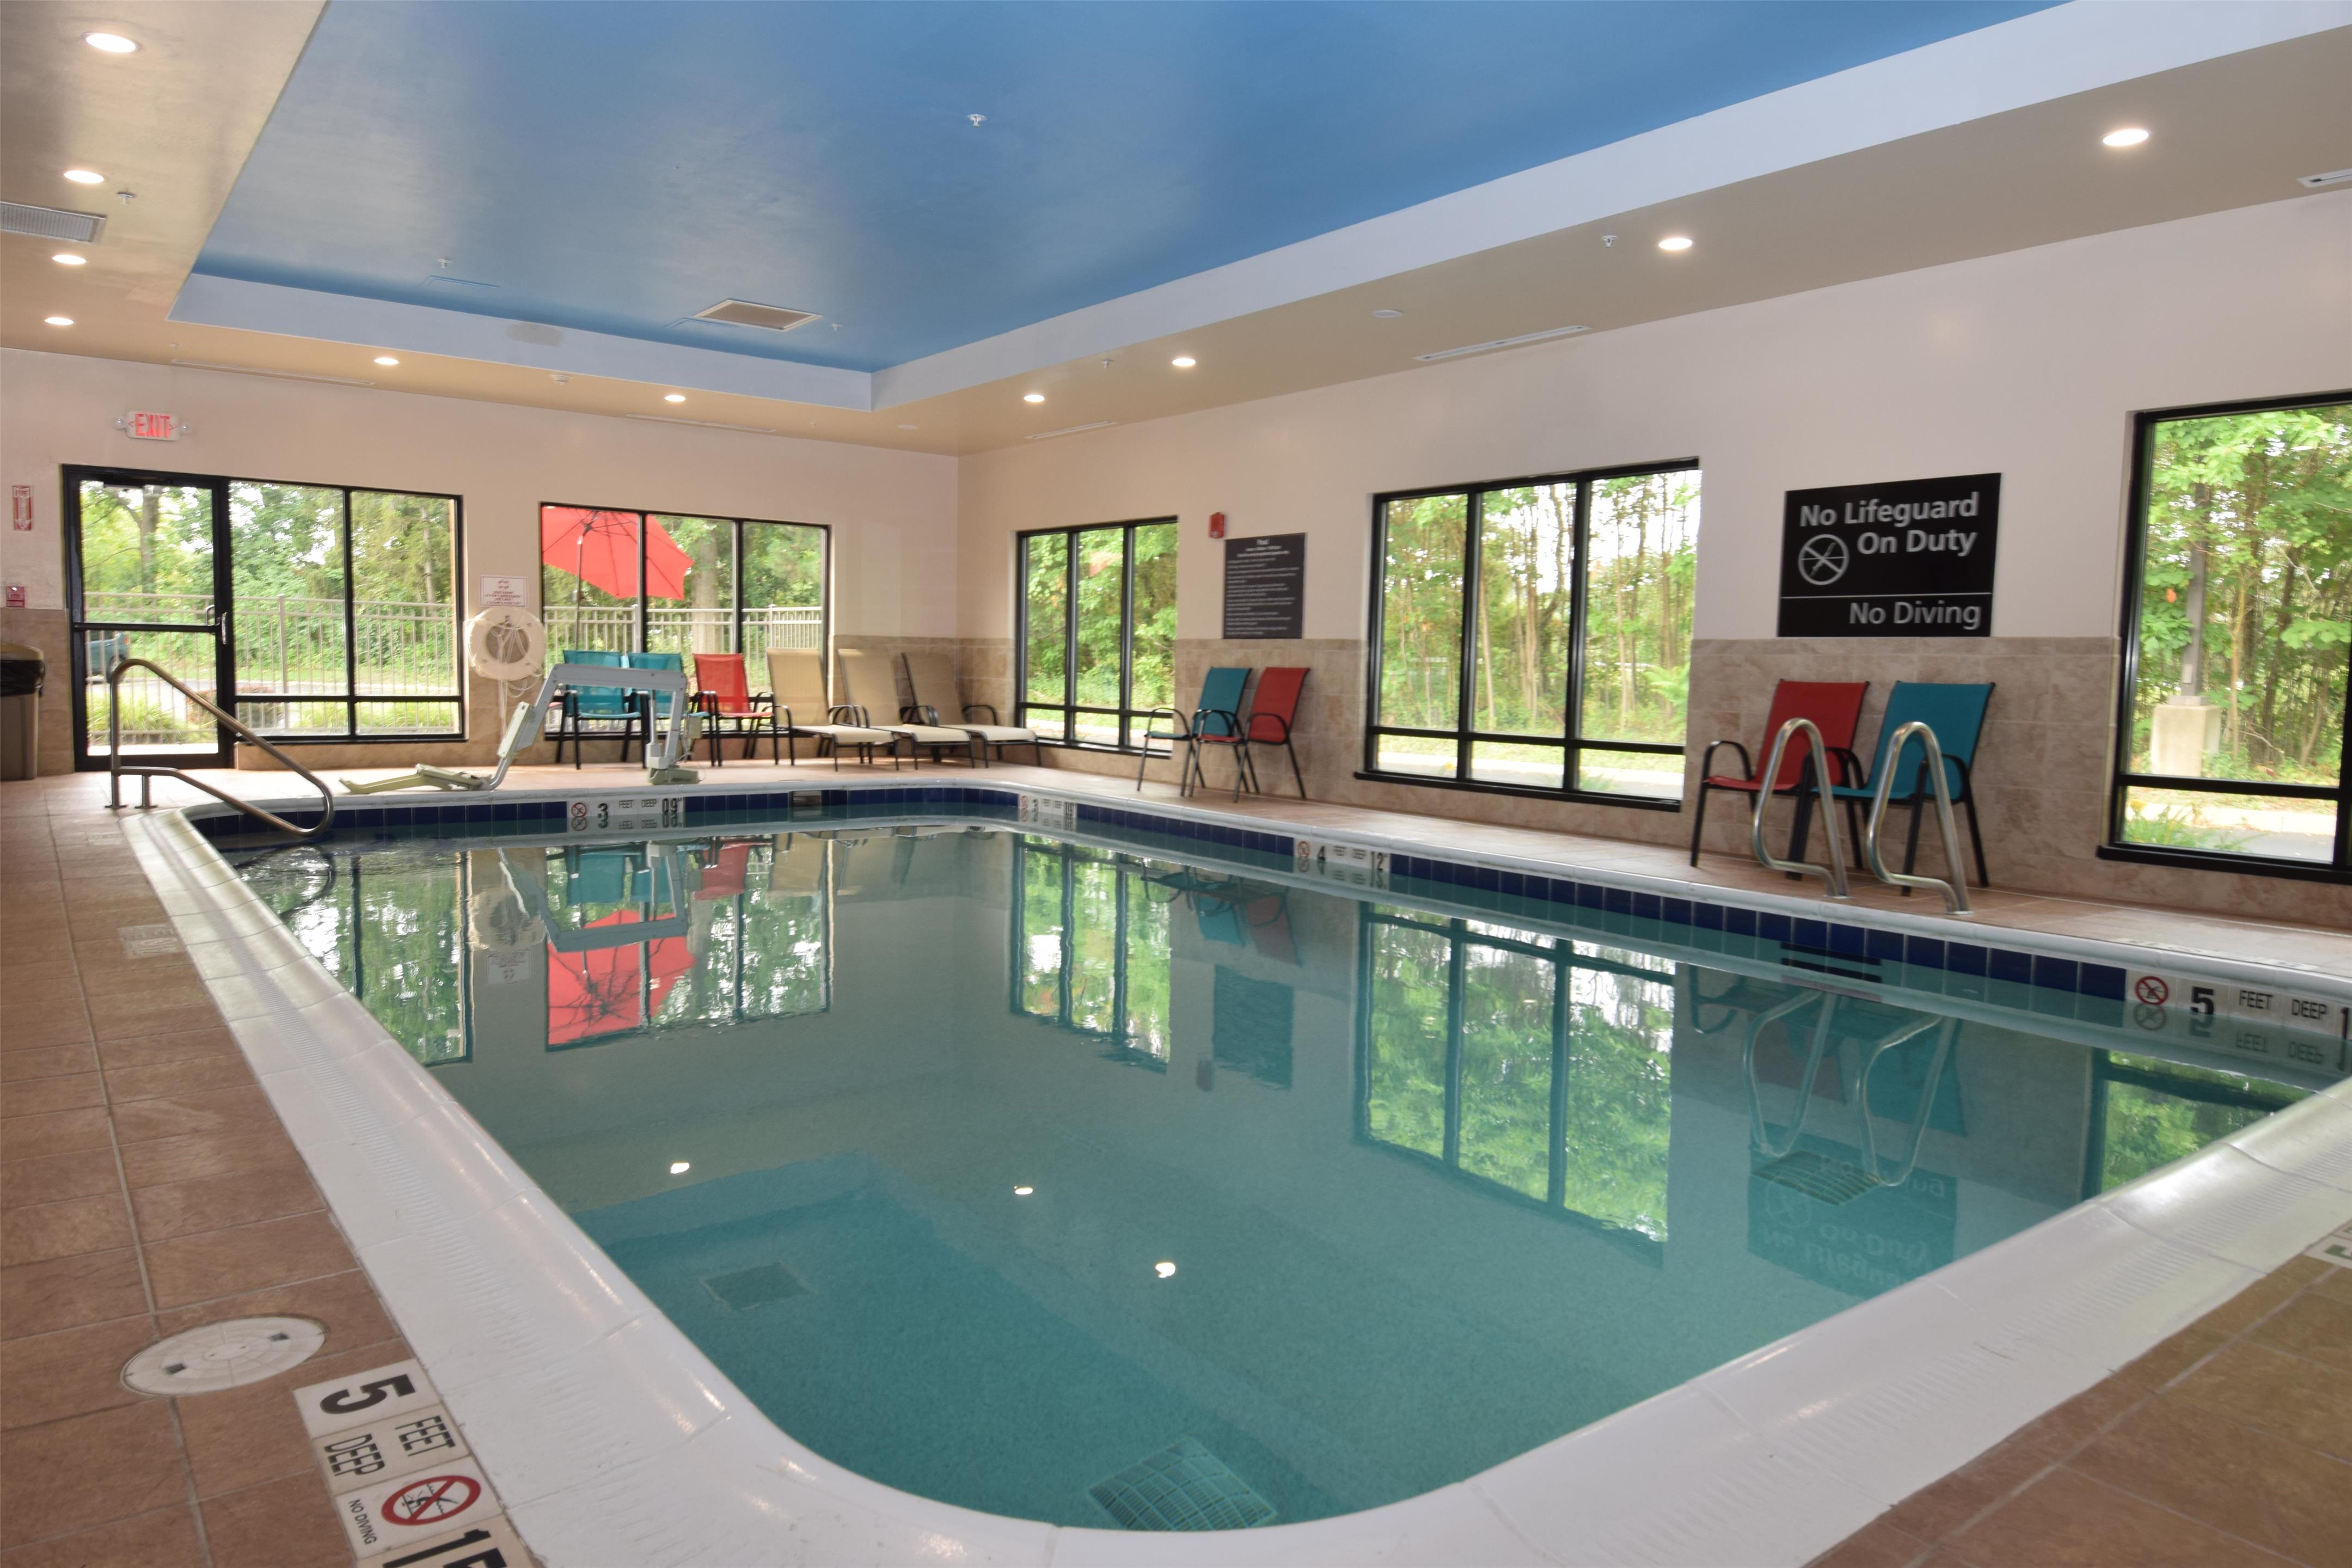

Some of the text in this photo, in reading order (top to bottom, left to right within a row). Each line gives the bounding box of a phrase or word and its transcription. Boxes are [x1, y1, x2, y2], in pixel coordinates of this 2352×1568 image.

[136, 413, 170, 438] EXIT
[1799, 491, 1980, 527] No Lifeguard
[1857, 529, 1977, 556] On Duty
[1849, 600, 1982, 630] No Diving
[597, 803, 608, 817] 3
[618, 800, 633, 808] FEET
[641, 799, 657, 808] DEEP
[2190, 986, 2214, 1015] 5
[2239, 990, 2273, 1010] FEET
[2292, 998, 2327, 1020] DEEP
[320, 1374, 416, 1414] 5
[395, 1415, 456, 1457] FEET
[324, 1433, 385, 1477] DEEP
[349, 1499, 378, 1545] NO DIVING
